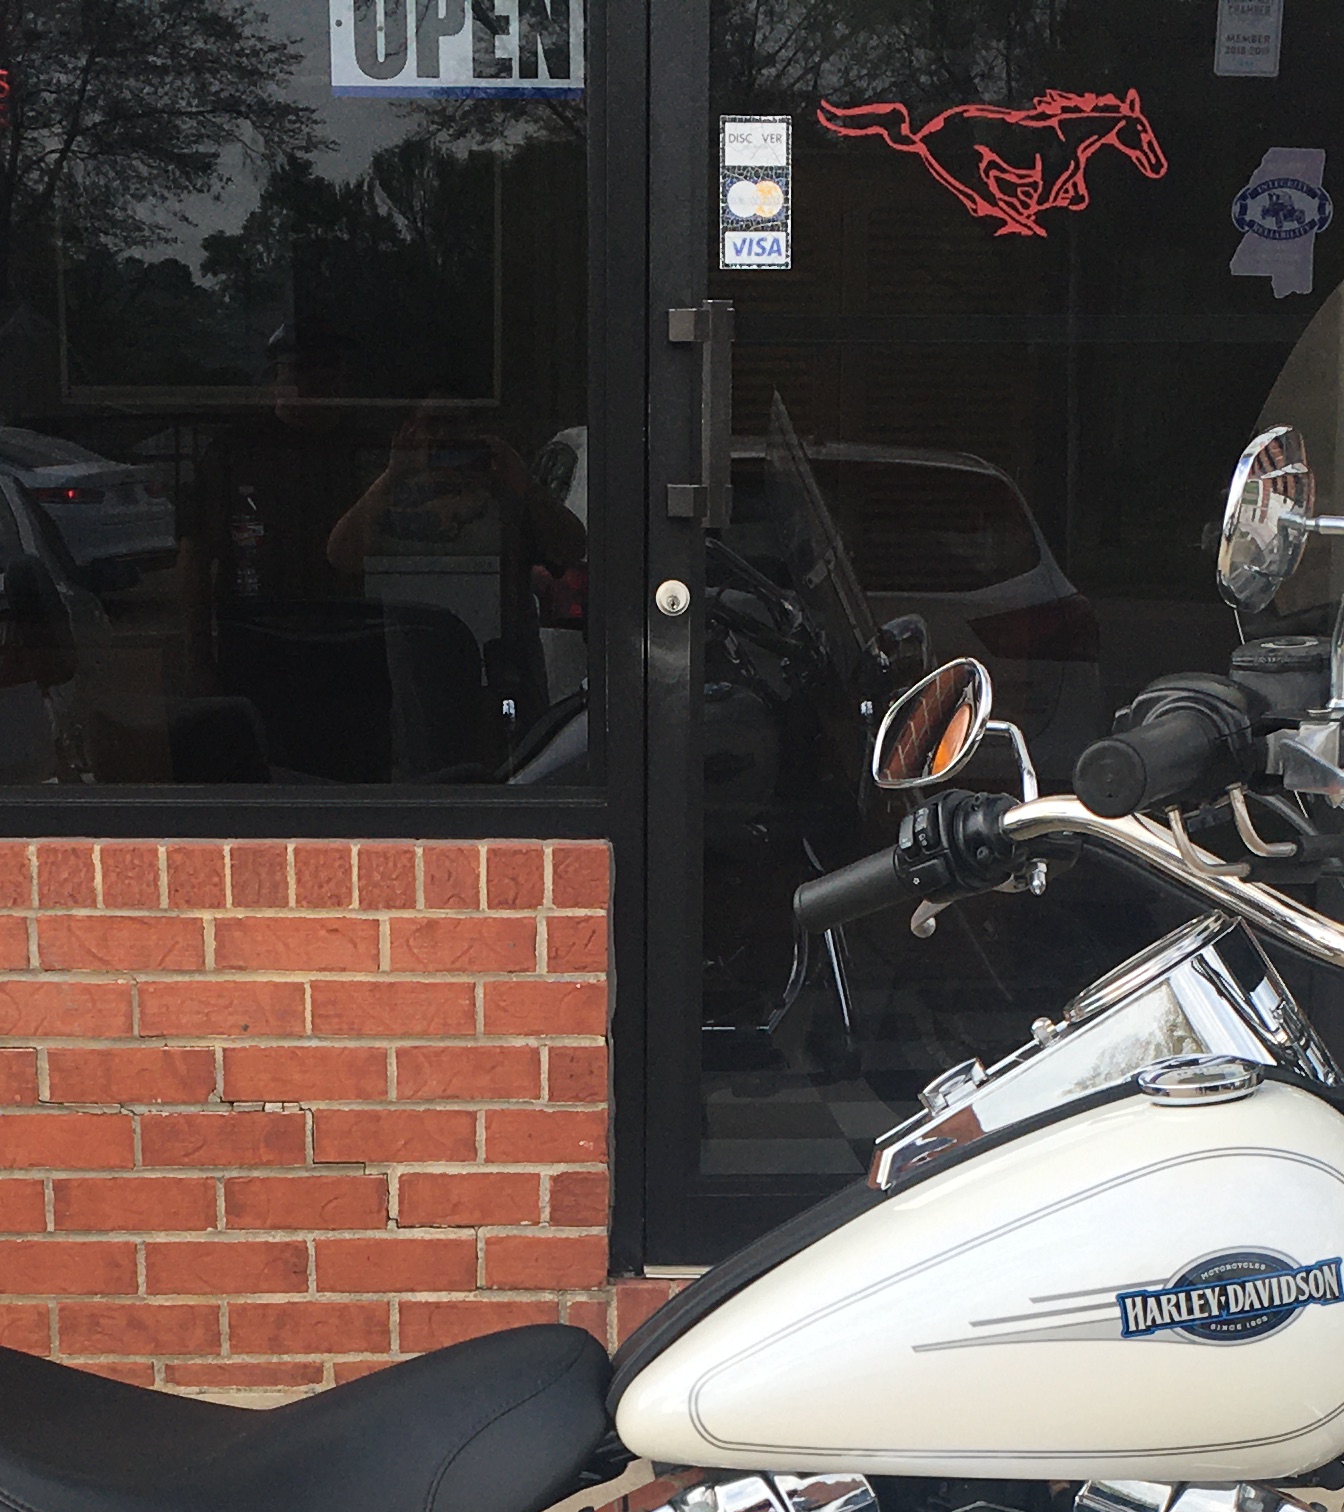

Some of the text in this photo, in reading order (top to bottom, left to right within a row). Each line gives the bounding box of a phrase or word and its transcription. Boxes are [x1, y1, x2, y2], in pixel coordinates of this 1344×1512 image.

[355, 0, 571, 80] OPEN
[1226, 34, 1271, 44] MEMBER
[728, 133, 783, 144] DISCVER
[732, 237, 783, 257] VISA
[1200, 1262, 1266, 1280] MOTORCYCLES
[1124, 1263, 1341, 1332] HARLEY-DAVIDSON
